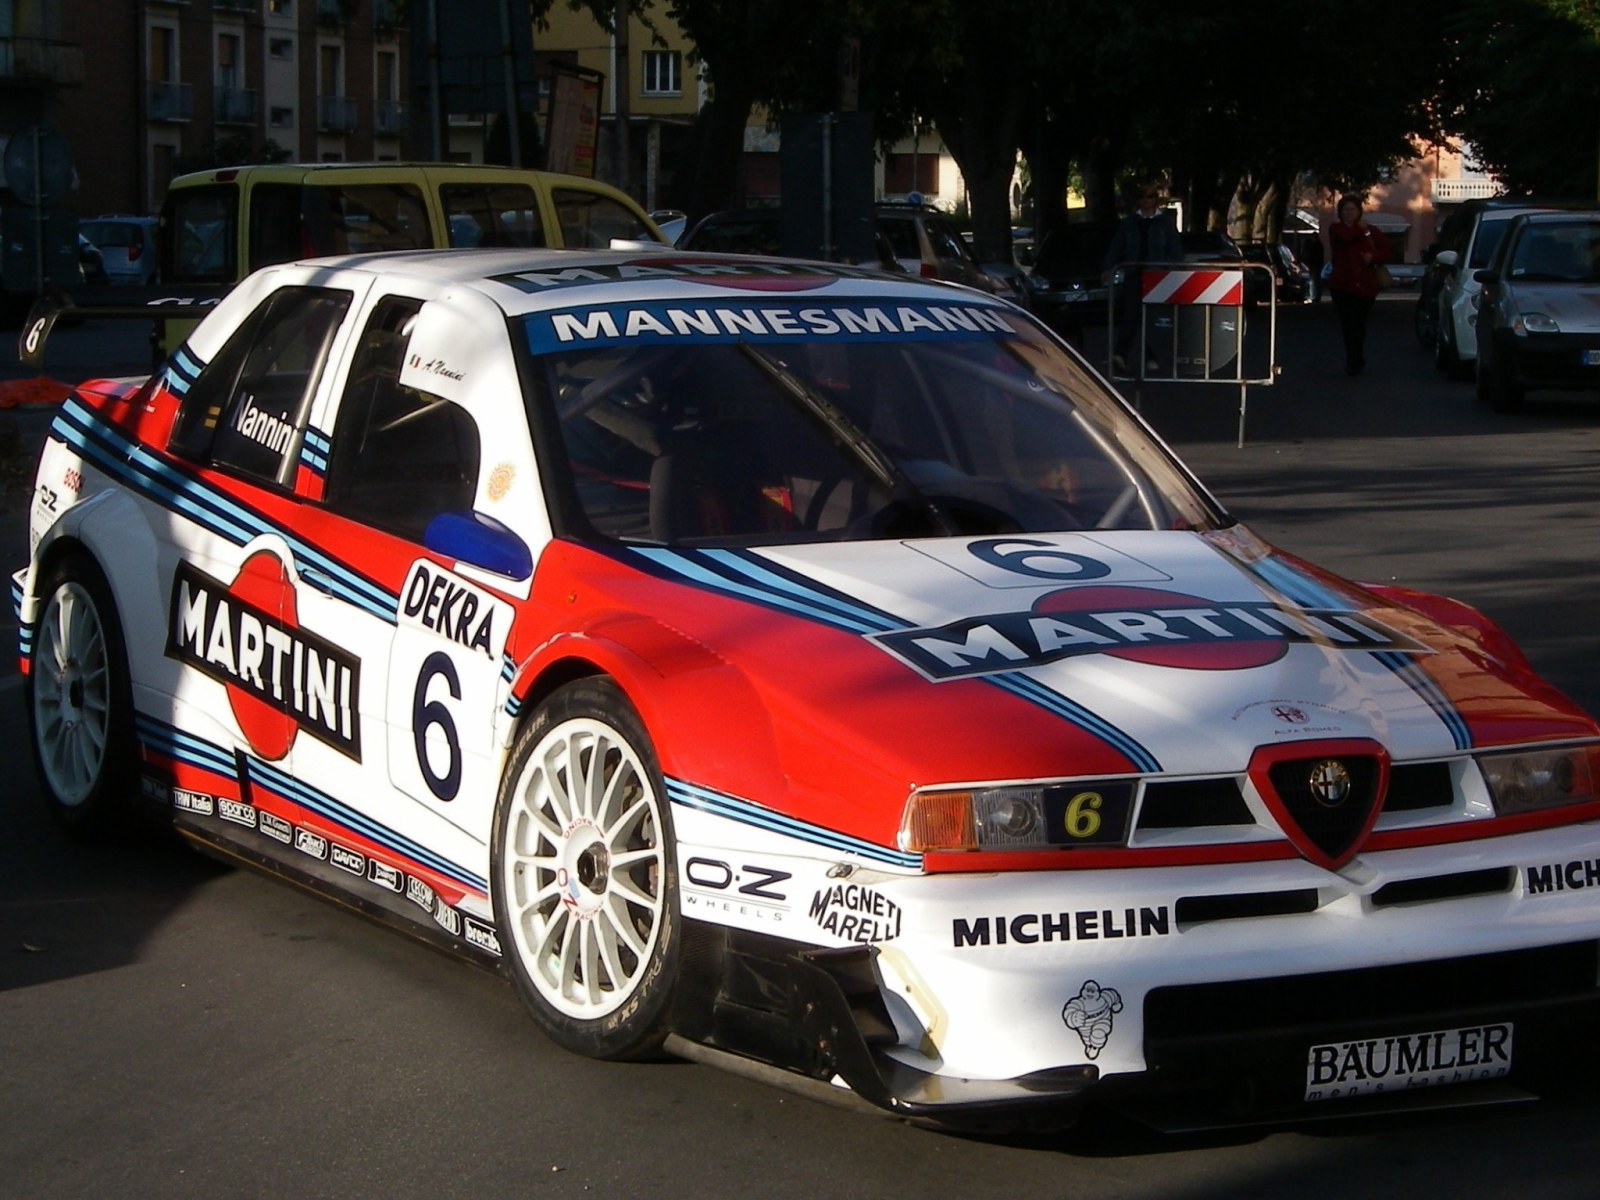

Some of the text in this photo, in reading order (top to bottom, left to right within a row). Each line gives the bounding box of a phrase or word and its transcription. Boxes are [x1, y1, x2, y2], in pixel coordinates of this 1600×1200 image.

[25, 316, 46, 354] 6
[550, 305, 1017, 342] MANNESMANN
[966, 538, 1112, 581] 6
[403, 564, 495, 661] DEKRA
[914, 607, 1392, 669] MARTINI
[176, 579, 352, 741] MARTINI
[412, 650, 463, 802] 6
[191, 794, 212, 812] Italia
[220, 799, 256, 821] sparco
[1064, 791, 1103, 838] 6
[1527, 858, 1600, 894] MICH
[686, 895, 783, 922] WHEELS
[809, 884, 902, 927] MAGNETI
[809, 897, 902, 943] MARELLI
[952, 905, 1169, 947] MICHELIN
[1310, 1024, 1509, 1085] BÄUMLER
[1307, 1081, 1385, 1100] men's
